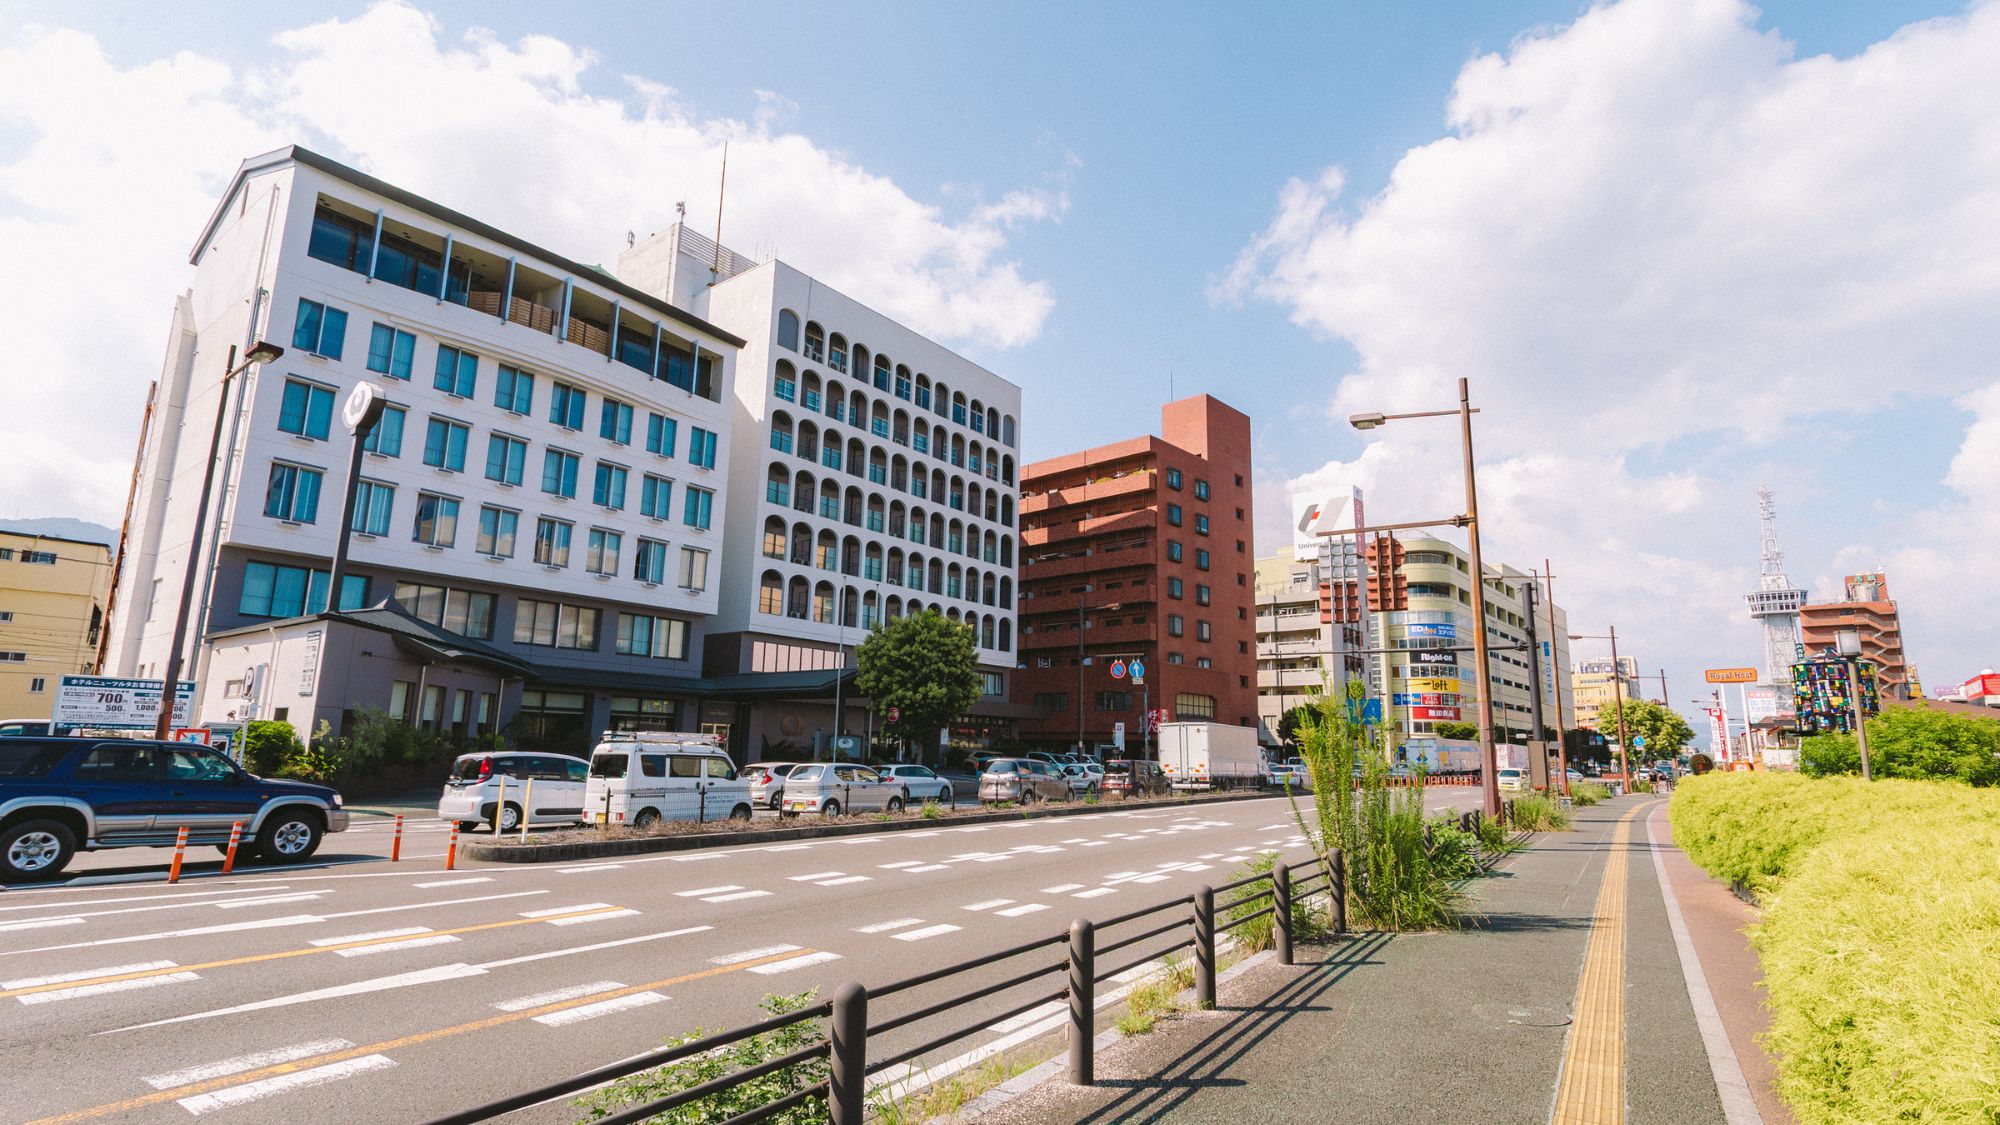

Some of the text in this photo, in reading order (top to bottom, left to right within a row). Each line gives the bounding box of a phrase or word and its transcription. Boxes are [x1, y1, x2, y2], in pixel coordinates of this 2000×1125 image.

[1411, 625, 1437, 634] EDION
[1421, 653, 1453, 662] Right-on
[1545, 663, 1553, 694] TOKIWA
[1710, 672, 1732, 680] Royal
[1432, 680, 1448, 690] Loft
